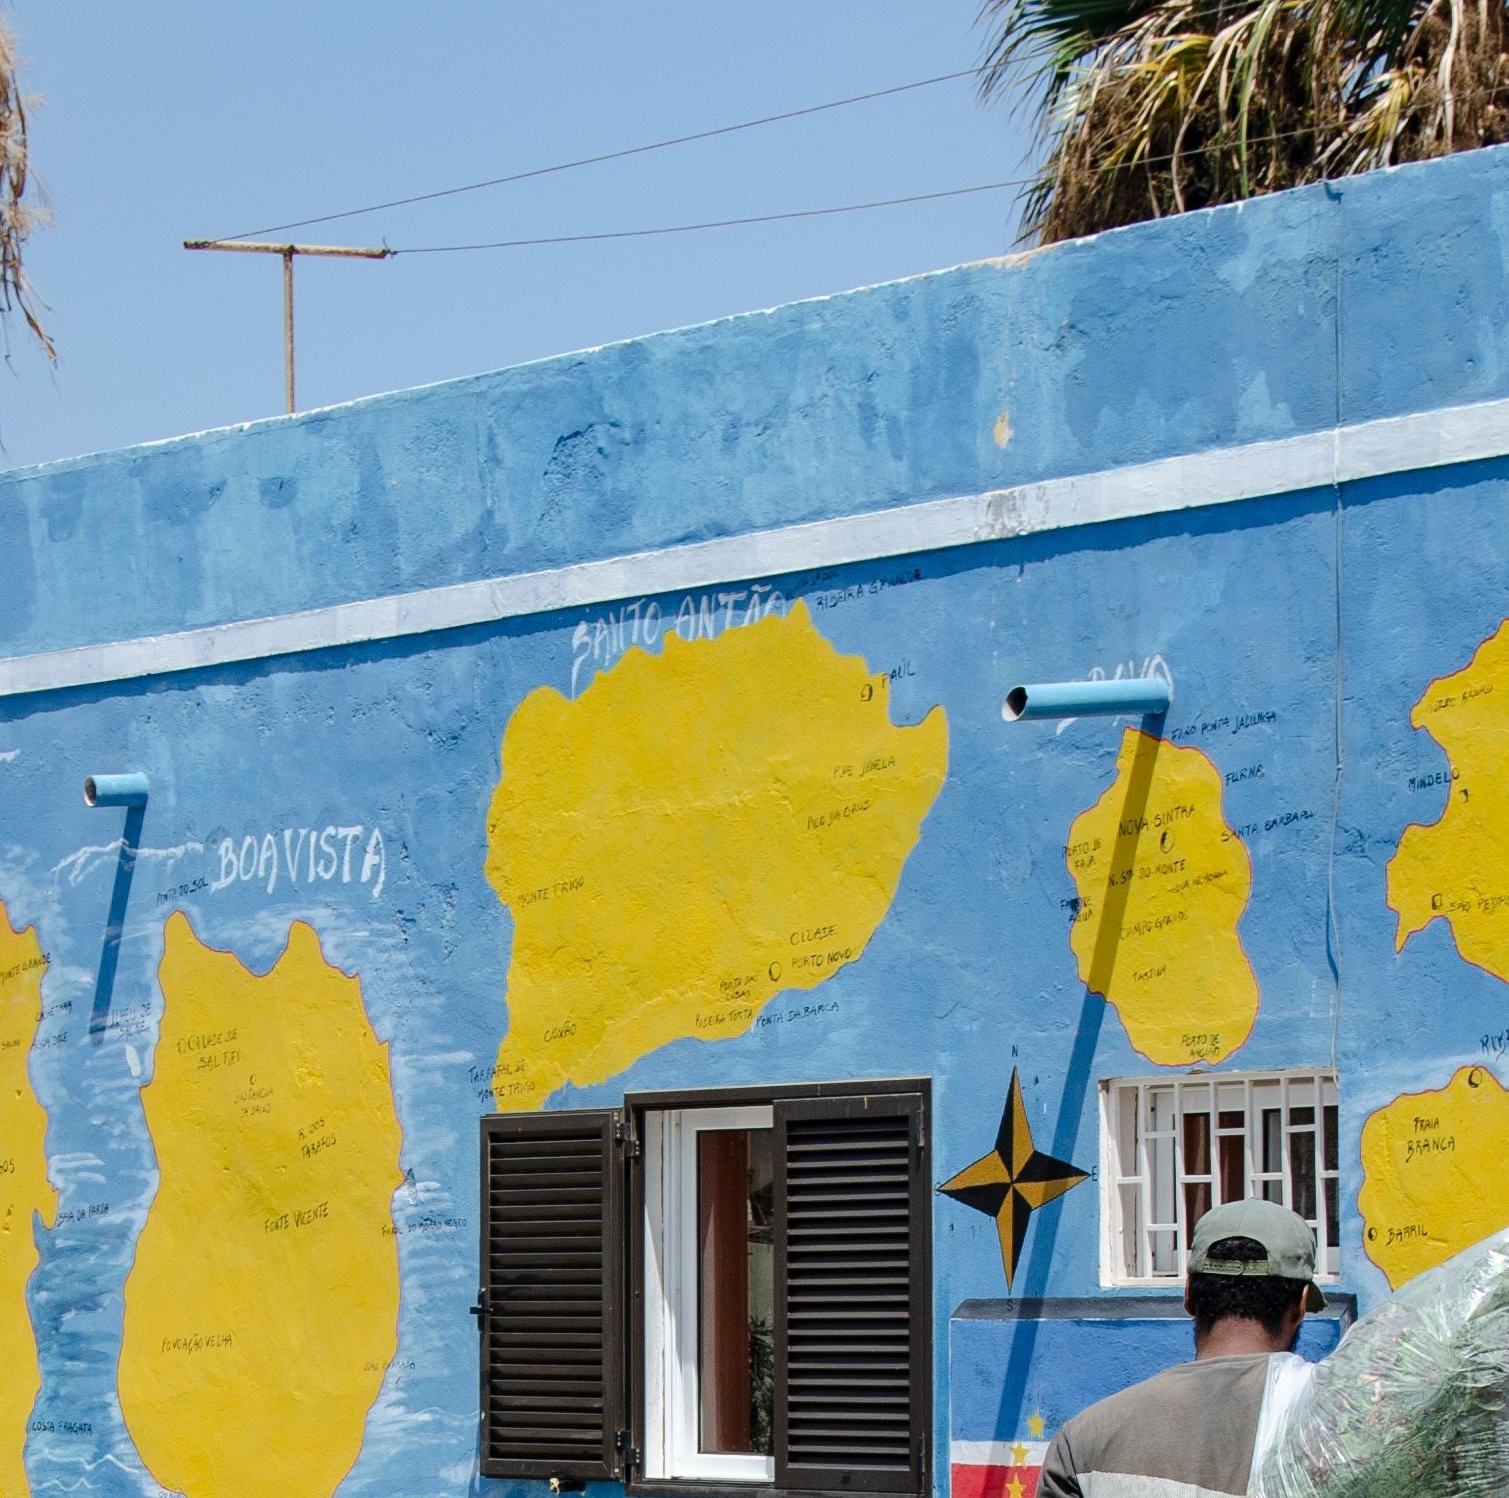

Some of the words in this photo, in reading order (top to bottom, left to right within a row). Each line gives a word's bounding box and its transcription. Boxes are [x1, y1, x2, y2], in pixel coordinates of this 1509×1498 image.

[571, 597, 663, 697] SANTO
[1408, 766, 1460, 792] MINDELO
[1118, 817, 1149, 838] NOVA
[1011, 1044, 1018, 1058] N
